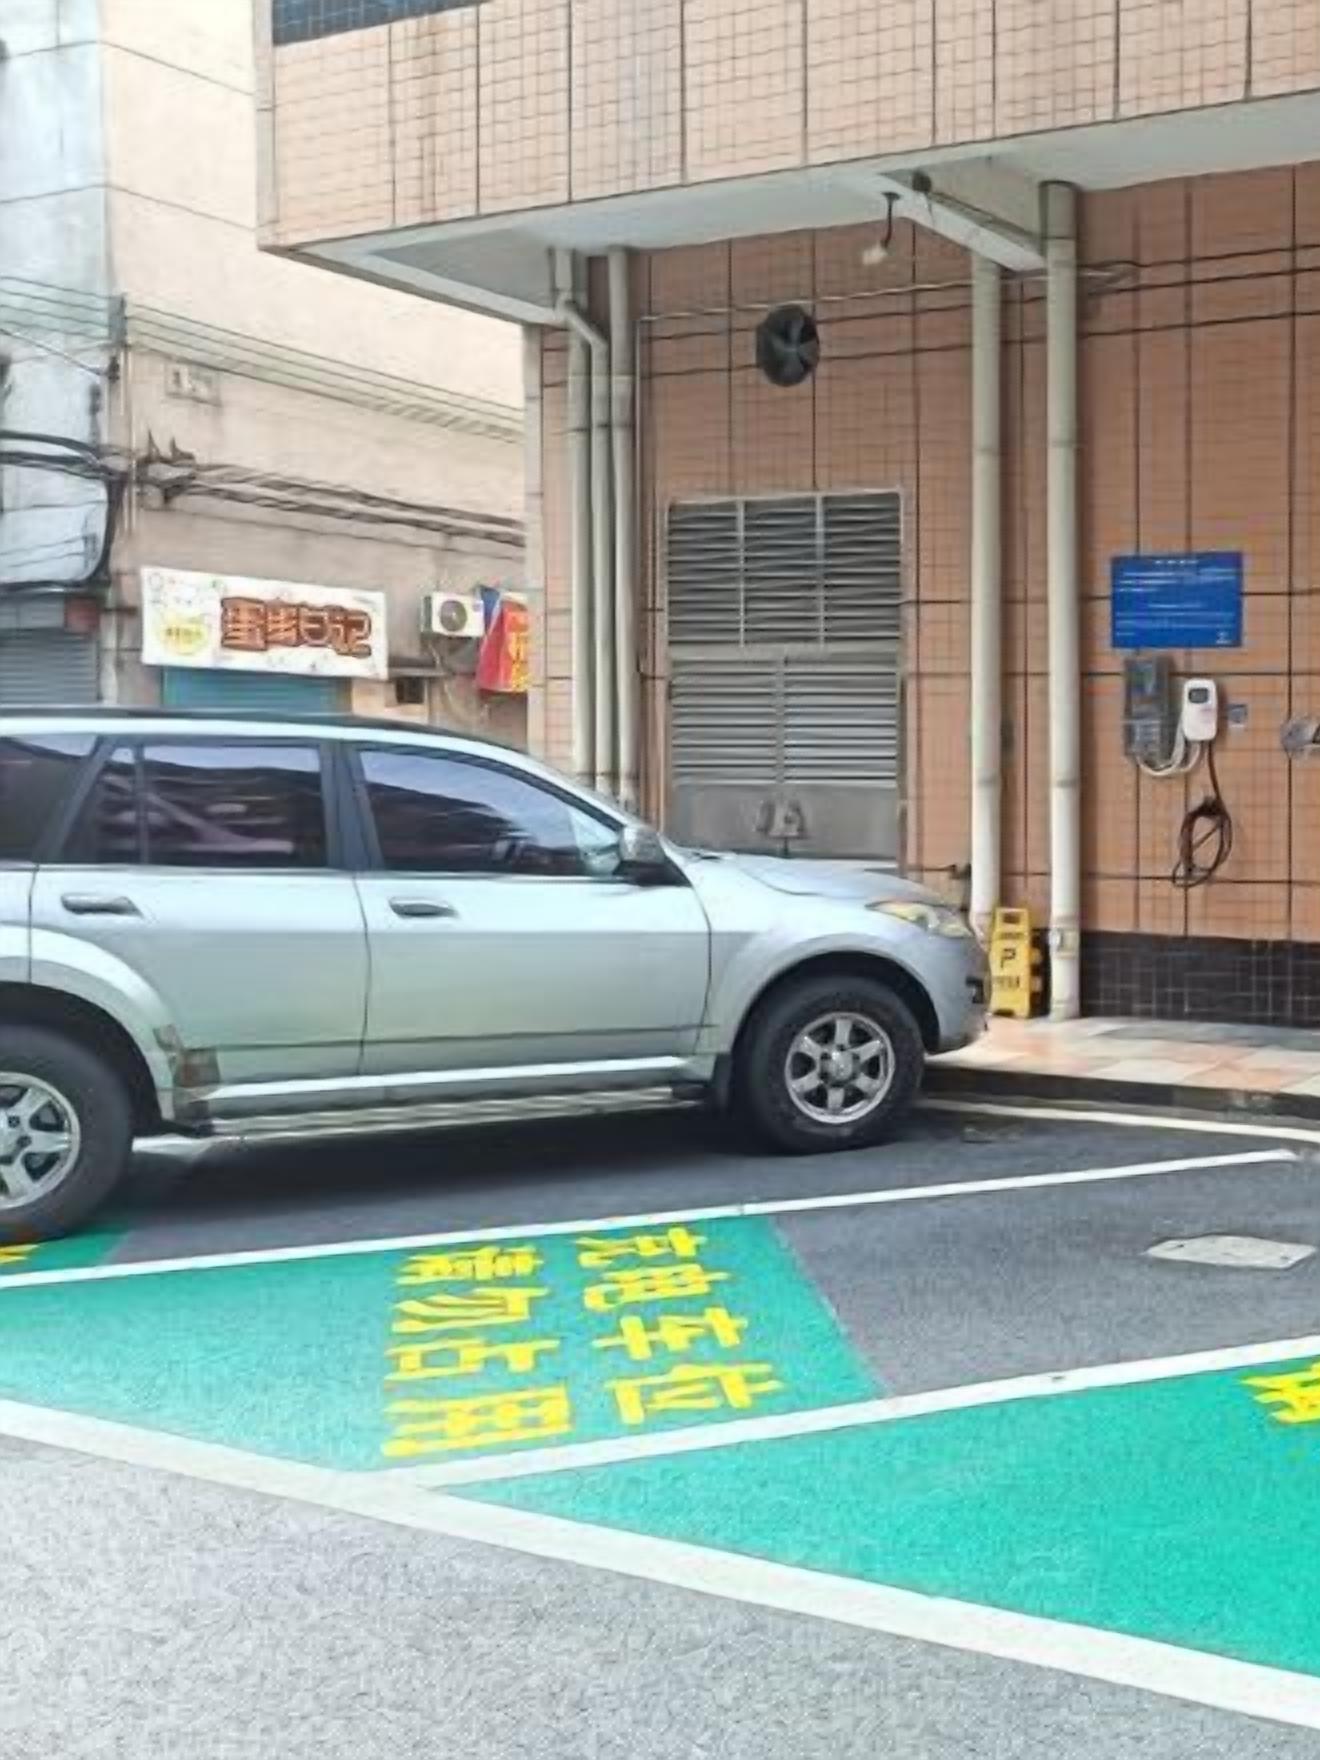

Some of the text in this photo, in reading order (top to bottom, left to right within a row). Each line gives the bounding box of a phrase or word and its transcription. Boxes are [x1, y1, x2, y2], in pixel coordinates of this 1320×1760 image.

[383, 1246, 573, 1457] 请勿占用
[577, 1226, 782, 1425] 充电车位
